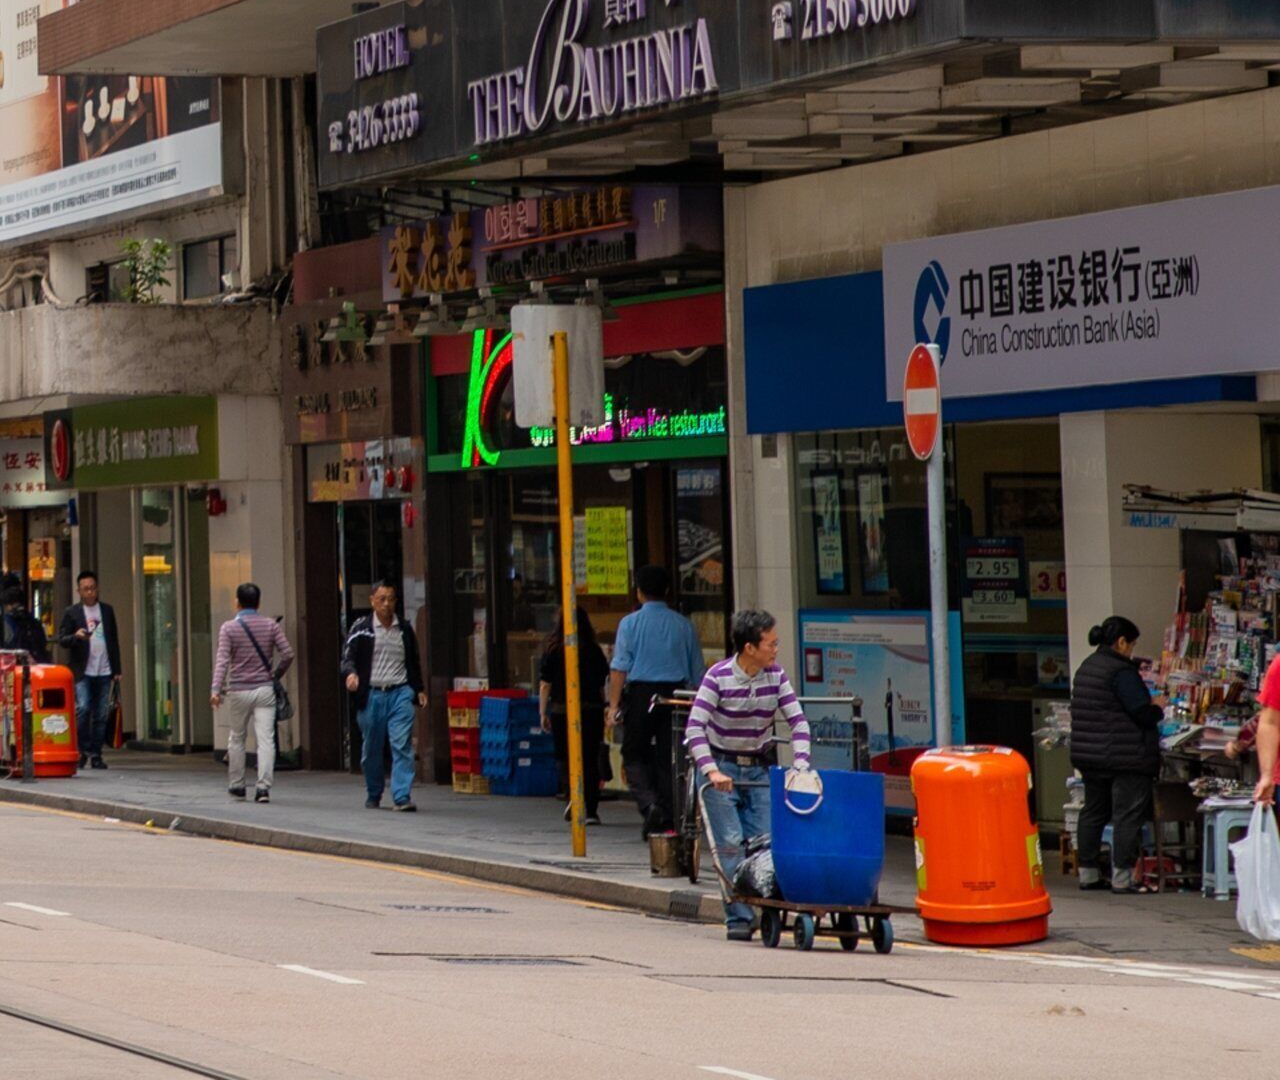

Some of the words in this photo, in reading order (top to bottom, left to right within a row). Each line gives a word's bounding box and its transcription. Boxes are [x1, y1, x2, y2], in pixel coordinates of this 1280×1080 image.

[353, 24, 410, 80] HOTEL
[346, 102, 384, 154] 3426
[382, 92, 420, 144] 3333
[468, 66, 525, 146] THE
[520, 246, 561, 280] Garden
[564, 231, 630, 272] Restaurant
[959, 246, 1200, 321] 中国建设银行(亞洲)
[961, 325, 997, 357] China
[1001, 318, 1082, 353] Construction
[1083, 312, 1119, 345] Bank
[1120, 307, 1161, 344] (Asia)
[975, 561, 1010, 576] 2.95
